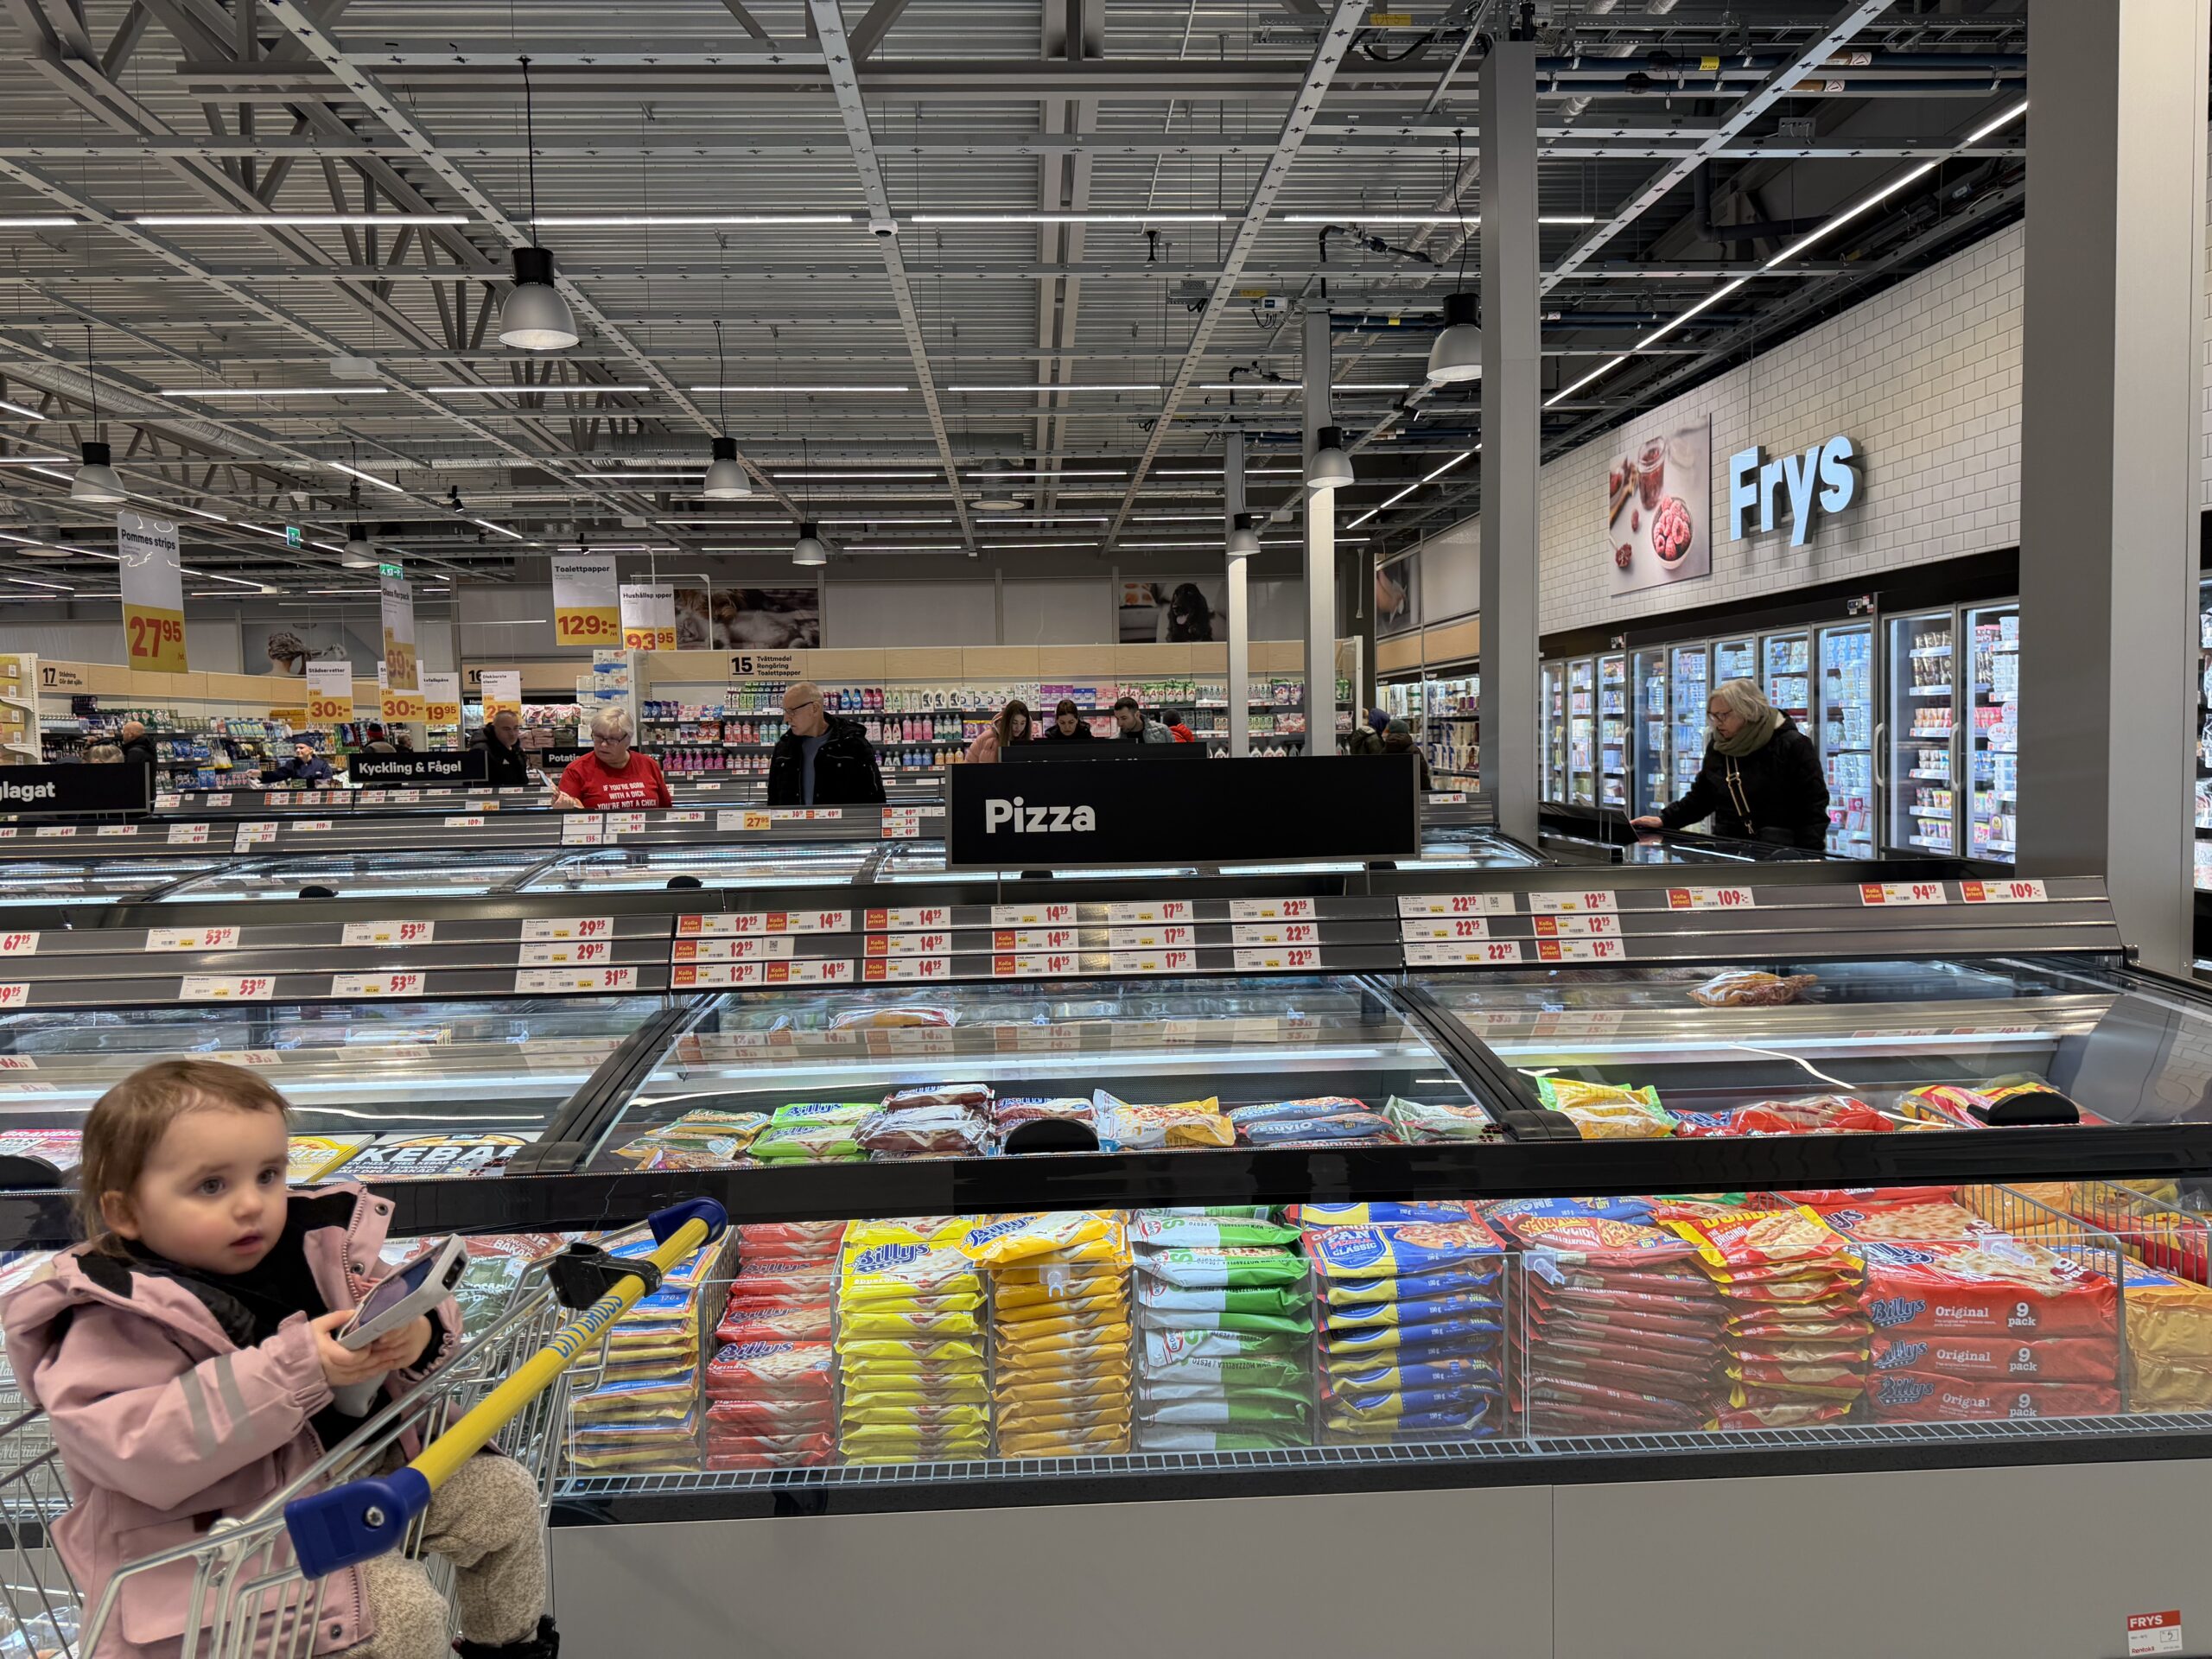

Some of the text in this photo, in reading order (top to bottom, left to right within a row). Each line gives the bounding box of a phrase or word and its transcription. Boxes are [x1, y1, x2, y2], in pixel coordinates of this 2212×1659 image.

[1729, 435, 1858, 547] Frys
[121, 529, 176, 550] Pommes strips
[555, 565, 610, 574] Toalettpapper
[558, 615, 617, 635] 129:-
[731, 657, 753, 672] 15
[42, 667, 56, 683] 17
[311, 701, 350, 717] 30:-
[384, 700, 423, 716] 30:-
[359, 760, 461, 777] Kyckling & Fågel
[985, 796, 1096, 834] Pizza
[785, 1103, 843, 1117] Billys
[961, 1215, 1038, 1247] Billys
[1328, 1230, 1370, 1243] PAN
[1707, 1229, 1719, 1239] THE
[850, 1243, 931, 1272] Billys
[1332, 1243, 1377, 1256] CLASSIC
[572, 1295, 623, 1333] GROSS
[728, 1306, 801, 1324] Billys
[1869, 1297, 2029, 1325] Billys Original 9
[2007, 1317, 2037, 1327] pack
[715, 1340, 794, 1363] Billys
[1877, 1340, 2031, 1367] illys Original 9
[2009, 1362, 2037, 1372] pack
[1877, 1376, 2031, 1408] Billys Orignal 9
[2009, 1408, 2037, 1417] pack
[2130, 1615, 2163, 1628] FRYS
